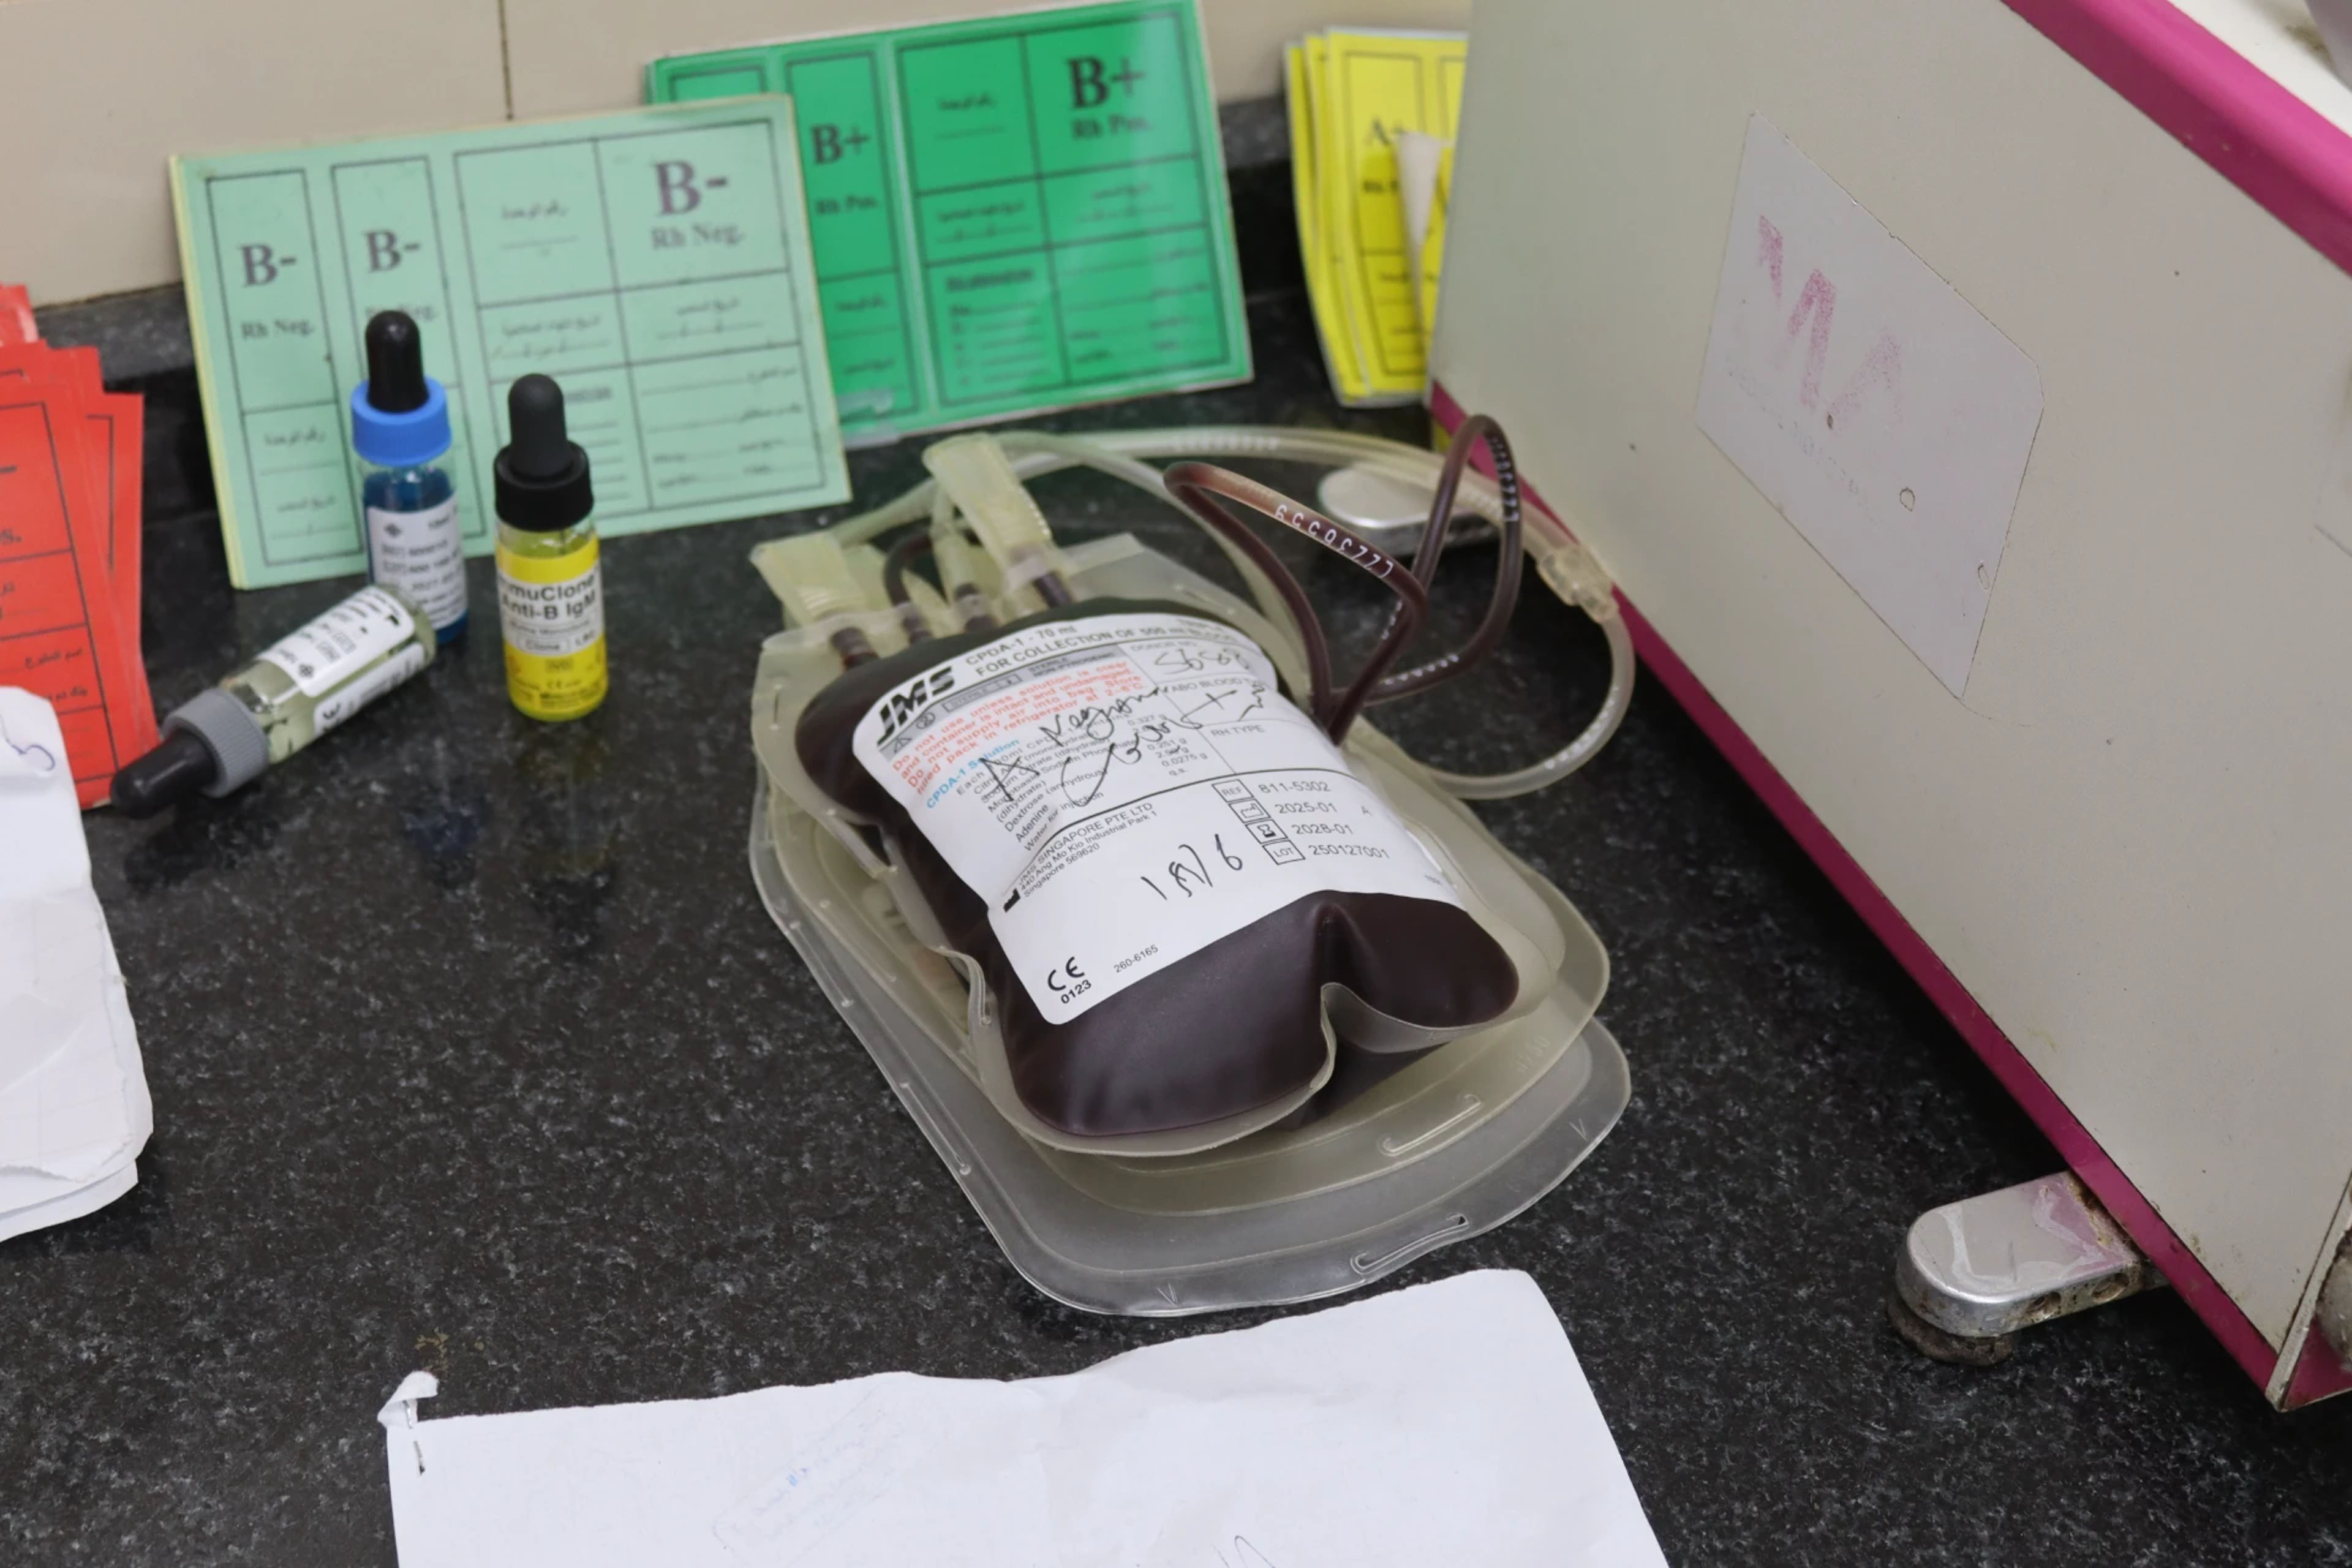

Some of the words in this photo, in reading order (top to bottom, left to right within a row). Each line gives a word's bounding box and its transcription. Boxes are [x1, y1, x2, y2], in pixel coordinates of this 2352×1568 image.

[1066, 54, 1145, 110] B+
[810, 124, 870, 165] B+
[652, 159, 728, 217] B-
[363, 229, 421, 274] B-
[651, 227, 685, 250] Rh
[239, 243, 296, 288] B-
[241, 320, 268, 340] Rh
[502, 594, 558, 620] Anti-B
[567, 590, 595, 619] IgM
[965, 638, 1024, 666] CPDA-1
[1041, 627, 1055, 639] 70
[976, 657, 1011, 677] FOR
[1013, 631, 1112, 663] COLLECTION
[1115, 626, 1139, 638] OF
[1172, 683, 1198, 693] ABO
[1199, 677, 1242, 688] BLOOD
[877, 666, 956, 746] JMS
[892, 753, 911, 772] Do
[914, 734, 935, 752] not
[940, 717, 965, 734] use
[970, 695, 1012, 717] unless
[1019, 674, 1072, 696] solution
[1127, 714, 1155, 726] 0.327
[901, 756, 921, 780] and
[922, 721, 976, 757] container
[979, 712, 992, 725] is
[994, 697, 1030, 720] intact
[1033, 687, 1057, 701] and
[908, 769, 925, 788] Do
[927, 746, 949, 764] not
[956, 720, 1003, 747] supply
[1008, 707, 1025, 720] air
[1033, 695, 1060, 710] into
[946, 741, 979, 765] pack
[982, 730, 998, 742] in
[1003, 699, 1079, 731] refrigerator
[1085, 693, 1099, 703] at
[1210, 728, 1232, 738] RH
[1234, 725, 1266, 734] TYPE
[956, 771, 986, 796] Each
[1027, 726, 1073, 748] CPD-1
[1041, 752, 1081, 774] Sodim
[1147, 739, 1176, 751] 0.251
[925, 768, 968, 809] CPDA-1
[981, 774, 1018, 804] Sodum
[996, 780, 1047, 823] (dihydrate)
[1015, 804, 1050, 843] Adenine
[1161, 754, 1198, 767] 0.0275
[1221, 786, 1243, 796] REF
[1257, 781, 1332, 794] 811-5302
[1274, 802, 1338, 815] 2025-01
[1005, 793, 1044, 834] Dextrose
[1023, 823, 1049, 852] Water
[1047, 808, 1060, 823] for
[1291, 823, 1354, 836] 2028-01
[1019, 865, 1036, 886] JMS
[1038, 821, 1104, 865] SINGAPORE
[1104, 812, 1130, 826] PTE
[1129, 802, 1153, 816] LTD
[1020, 875, 1036, 892] 440
[1035, 862, 1053, 880] Ang
[1052, 851, 1068, 864] Mo
[1067, 840, 1085, 853] Kio
[1085, 822, 1128, 846] Industrial
[1128, 814, 1151, 827] Park
[1273, 847, 1296, 858] LOT
[1308, 845, 1391, 859] 250127001
[1023, 862, 1065, 899] Singapore
[1067, 843, 1101, 865] 569620
[1047, 956, 1085, 992] CE
[1113, 944, 1159, 974] 260-6165
[1060, 979, 1092, 1005] 0123
